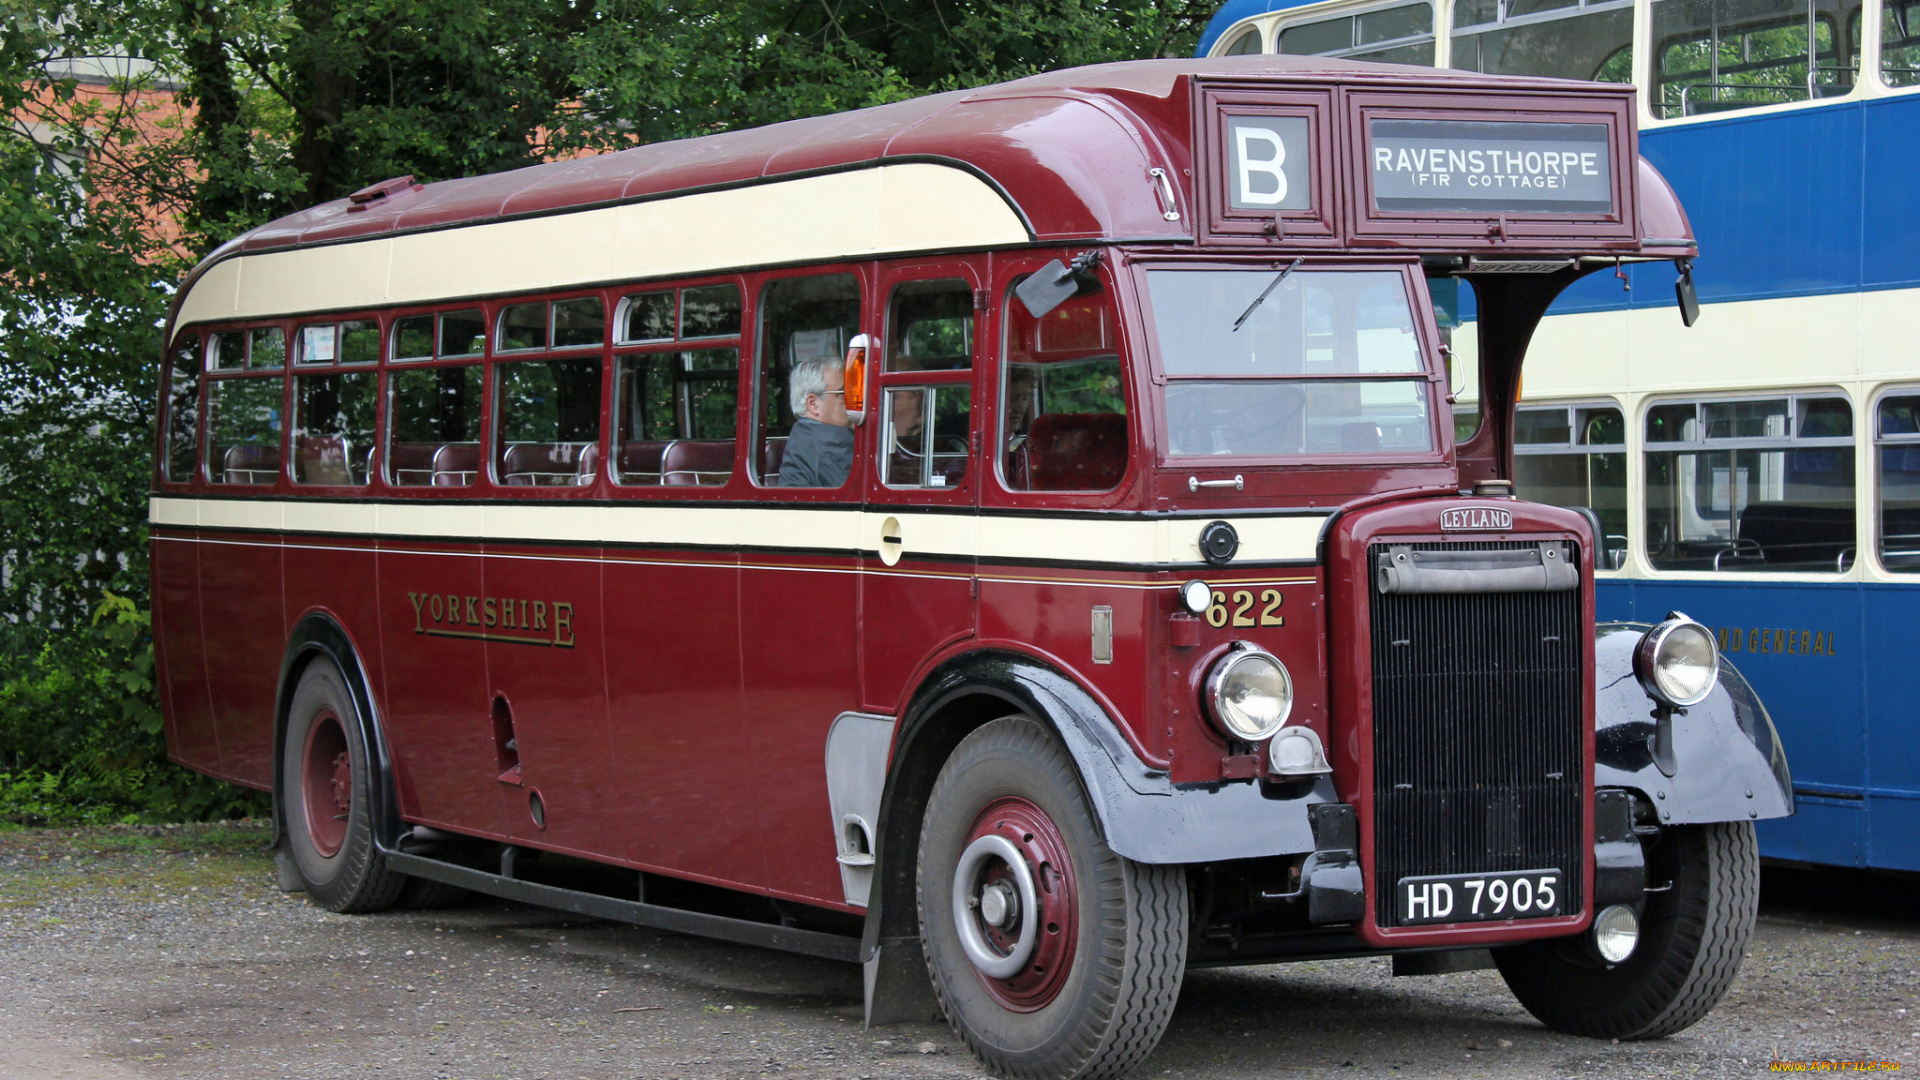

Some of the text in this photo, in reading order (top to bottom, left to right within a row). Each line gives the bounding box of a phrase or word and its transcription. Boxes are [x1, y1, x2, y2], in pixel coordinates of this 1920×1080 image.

[1235, 126, 1288, 205] B
[1374, 147, 1599, 176] RAVENSTHORPE
[1411, 171, 1567, 189] (FIR COTTAGE)
[1443, 509, 1511, 528] LEYLAND
[407, 592, 575, 648] YORKSHIRE
[1206, 588, 1285, 628] 622
[1709, 627, 1836, 656] ND GENERAL
[1407, 876, 1557, 919] HD 7905
